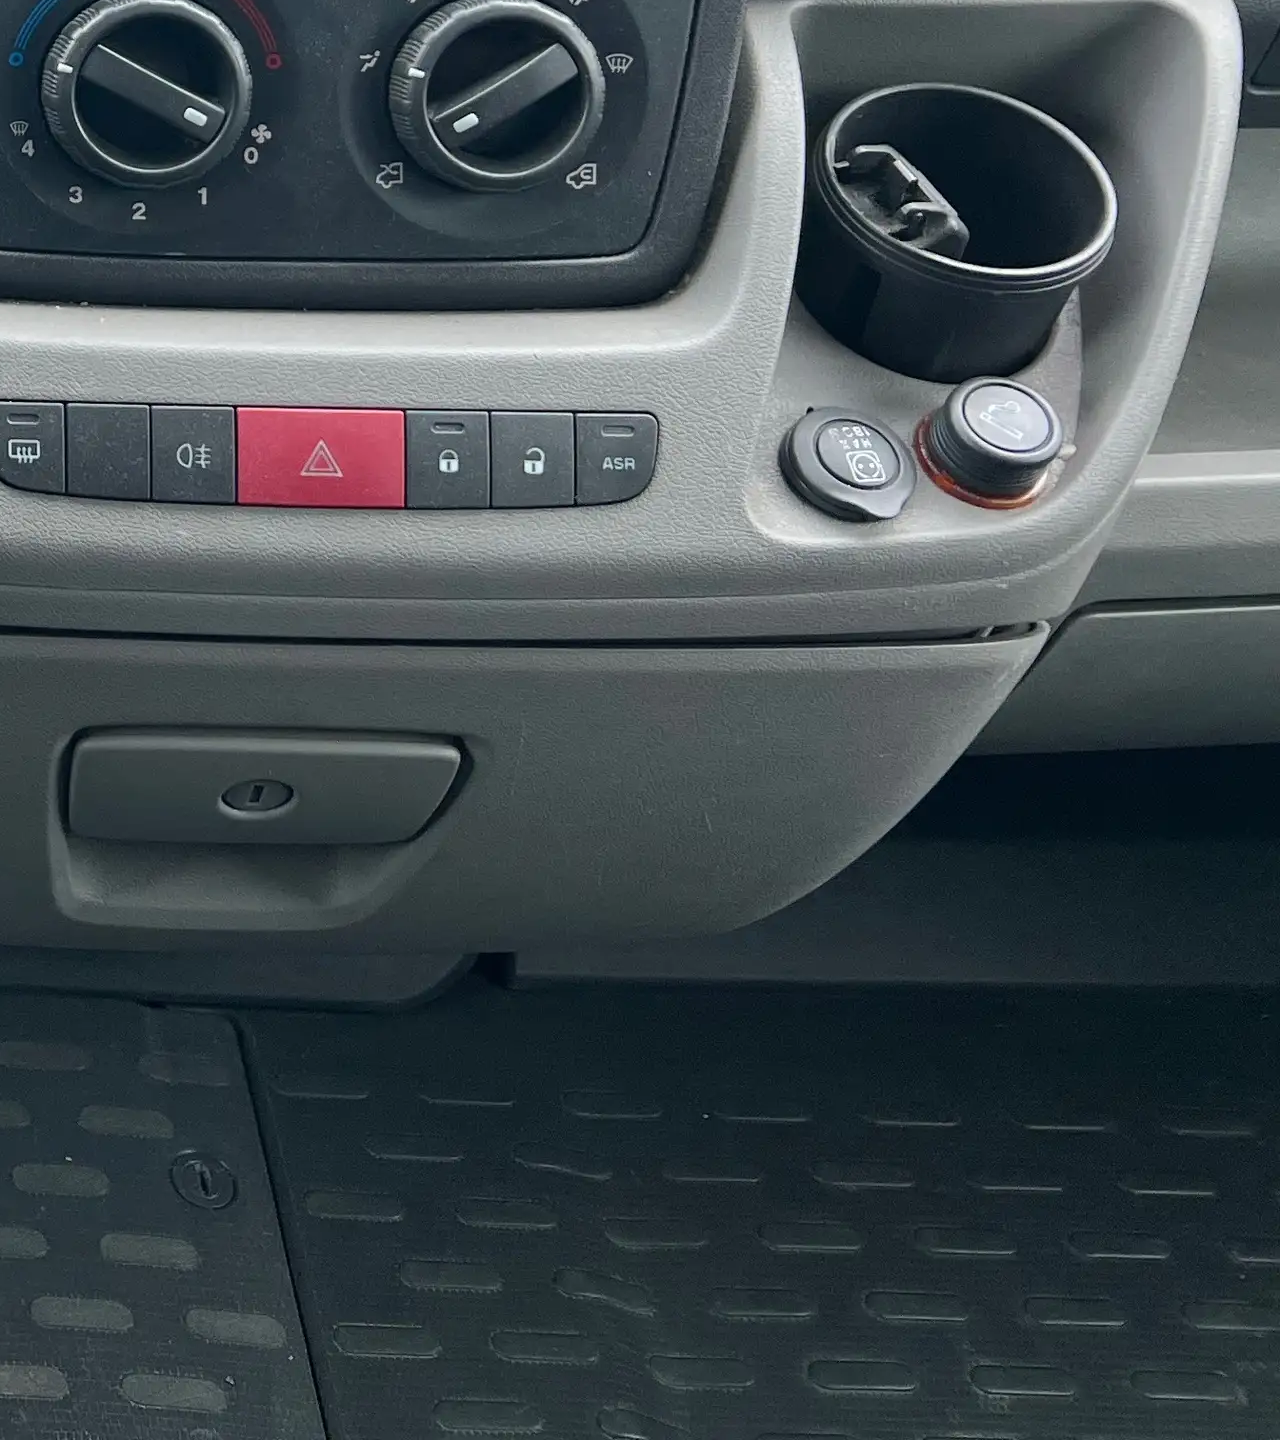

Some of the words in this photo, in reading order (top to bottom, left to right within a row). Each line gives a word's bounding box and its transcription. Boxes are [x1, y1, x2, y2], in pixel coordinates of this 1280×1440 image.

[21, 139, 35, 157] 4
[243, 146, 259, 165] 0
[68, 185, 83, 204] 3
[197, 187, 208, 205] 1
[131, 202, 147, 220] 2
[602, 456, 636, 470] ASR
